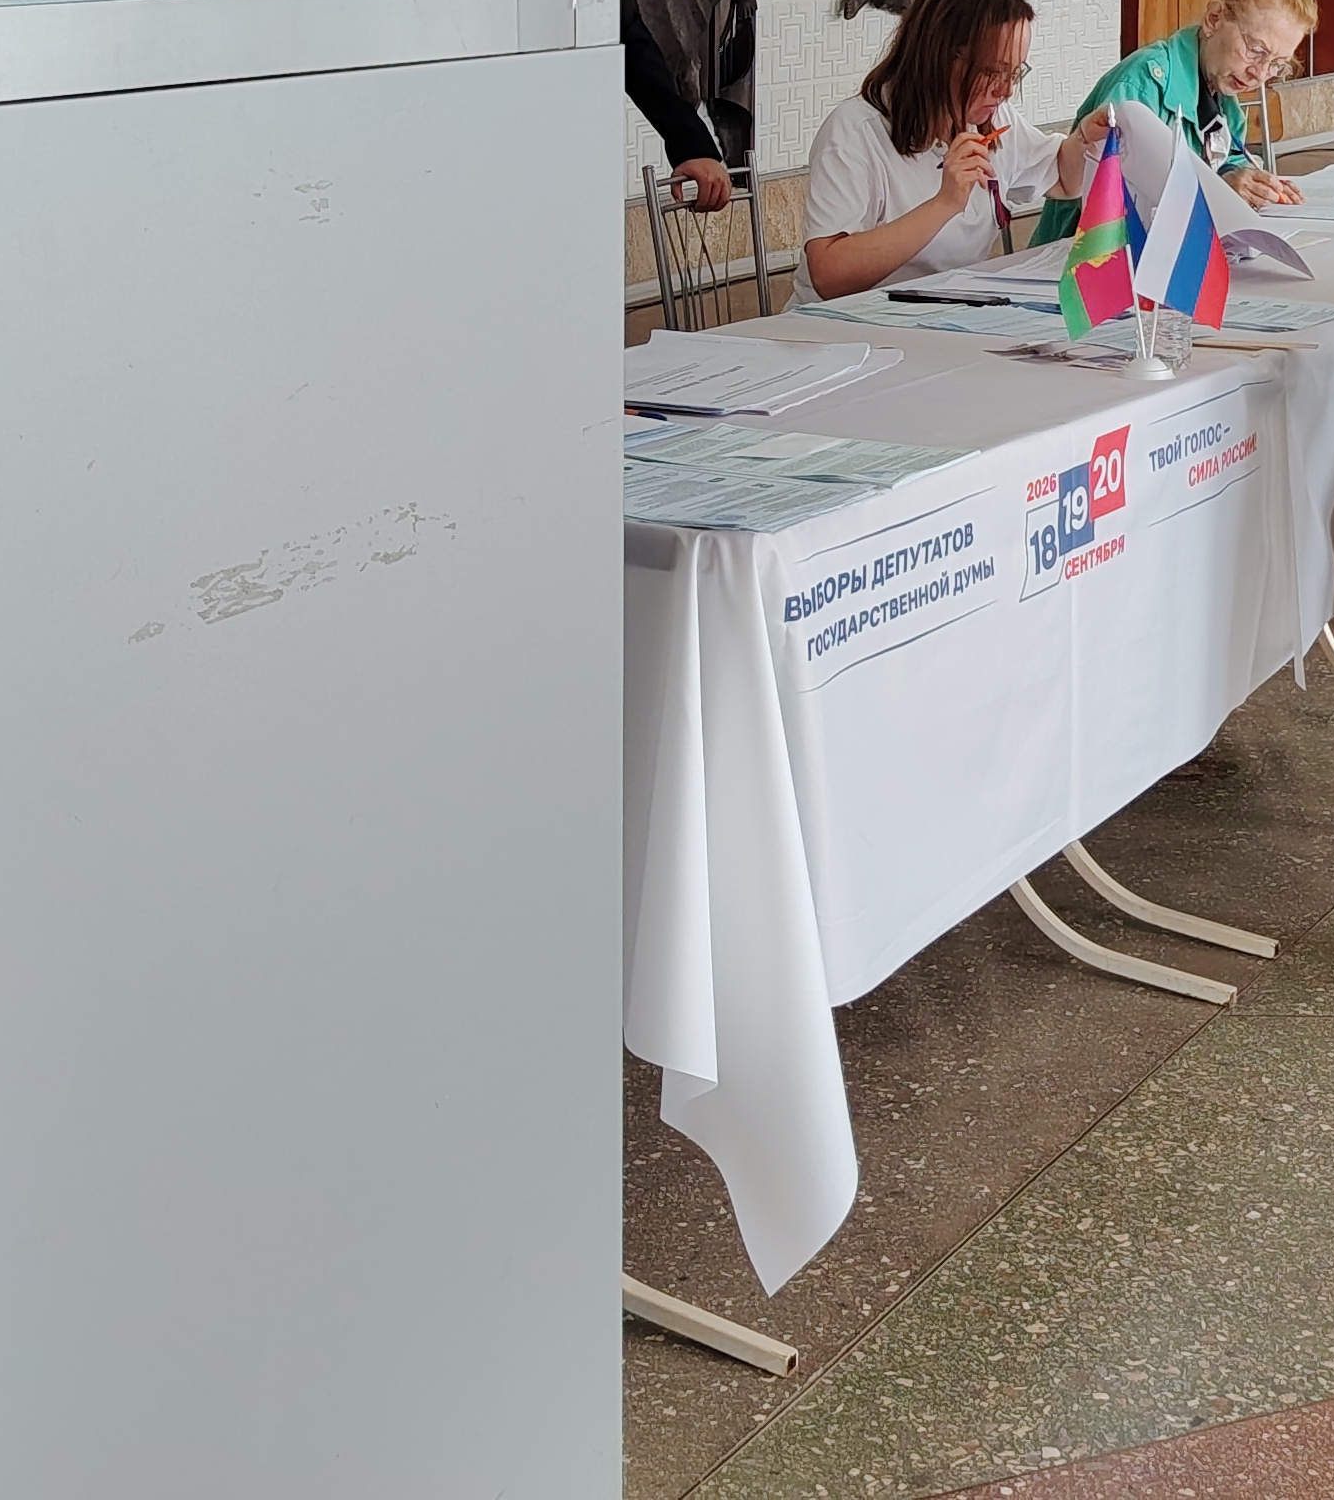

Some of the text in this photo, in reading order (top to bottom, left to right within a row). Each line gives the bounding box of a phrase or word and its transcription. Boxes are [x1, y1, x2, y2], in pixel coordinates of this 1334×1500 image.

[1149, 434, 1182, 472] ТВОЙ
[1184, 422, 1222, 454] ГОЛОС
[1189, 432, 1257, 487] СИЛА РОССИИ!
[1027, 473, 1056, 502] 2026
[1030, 449, 1122, 575] 18 19 20
[784, 523, 974, 622] ВЫБОРЫ ДЕПУТАТОВ
[1064, 534, 1125, 580] СЕНТЯБРЯ
[808, 556, 994, 661] ГОСУДАРСТВЕННОЙ ДУМЫ
